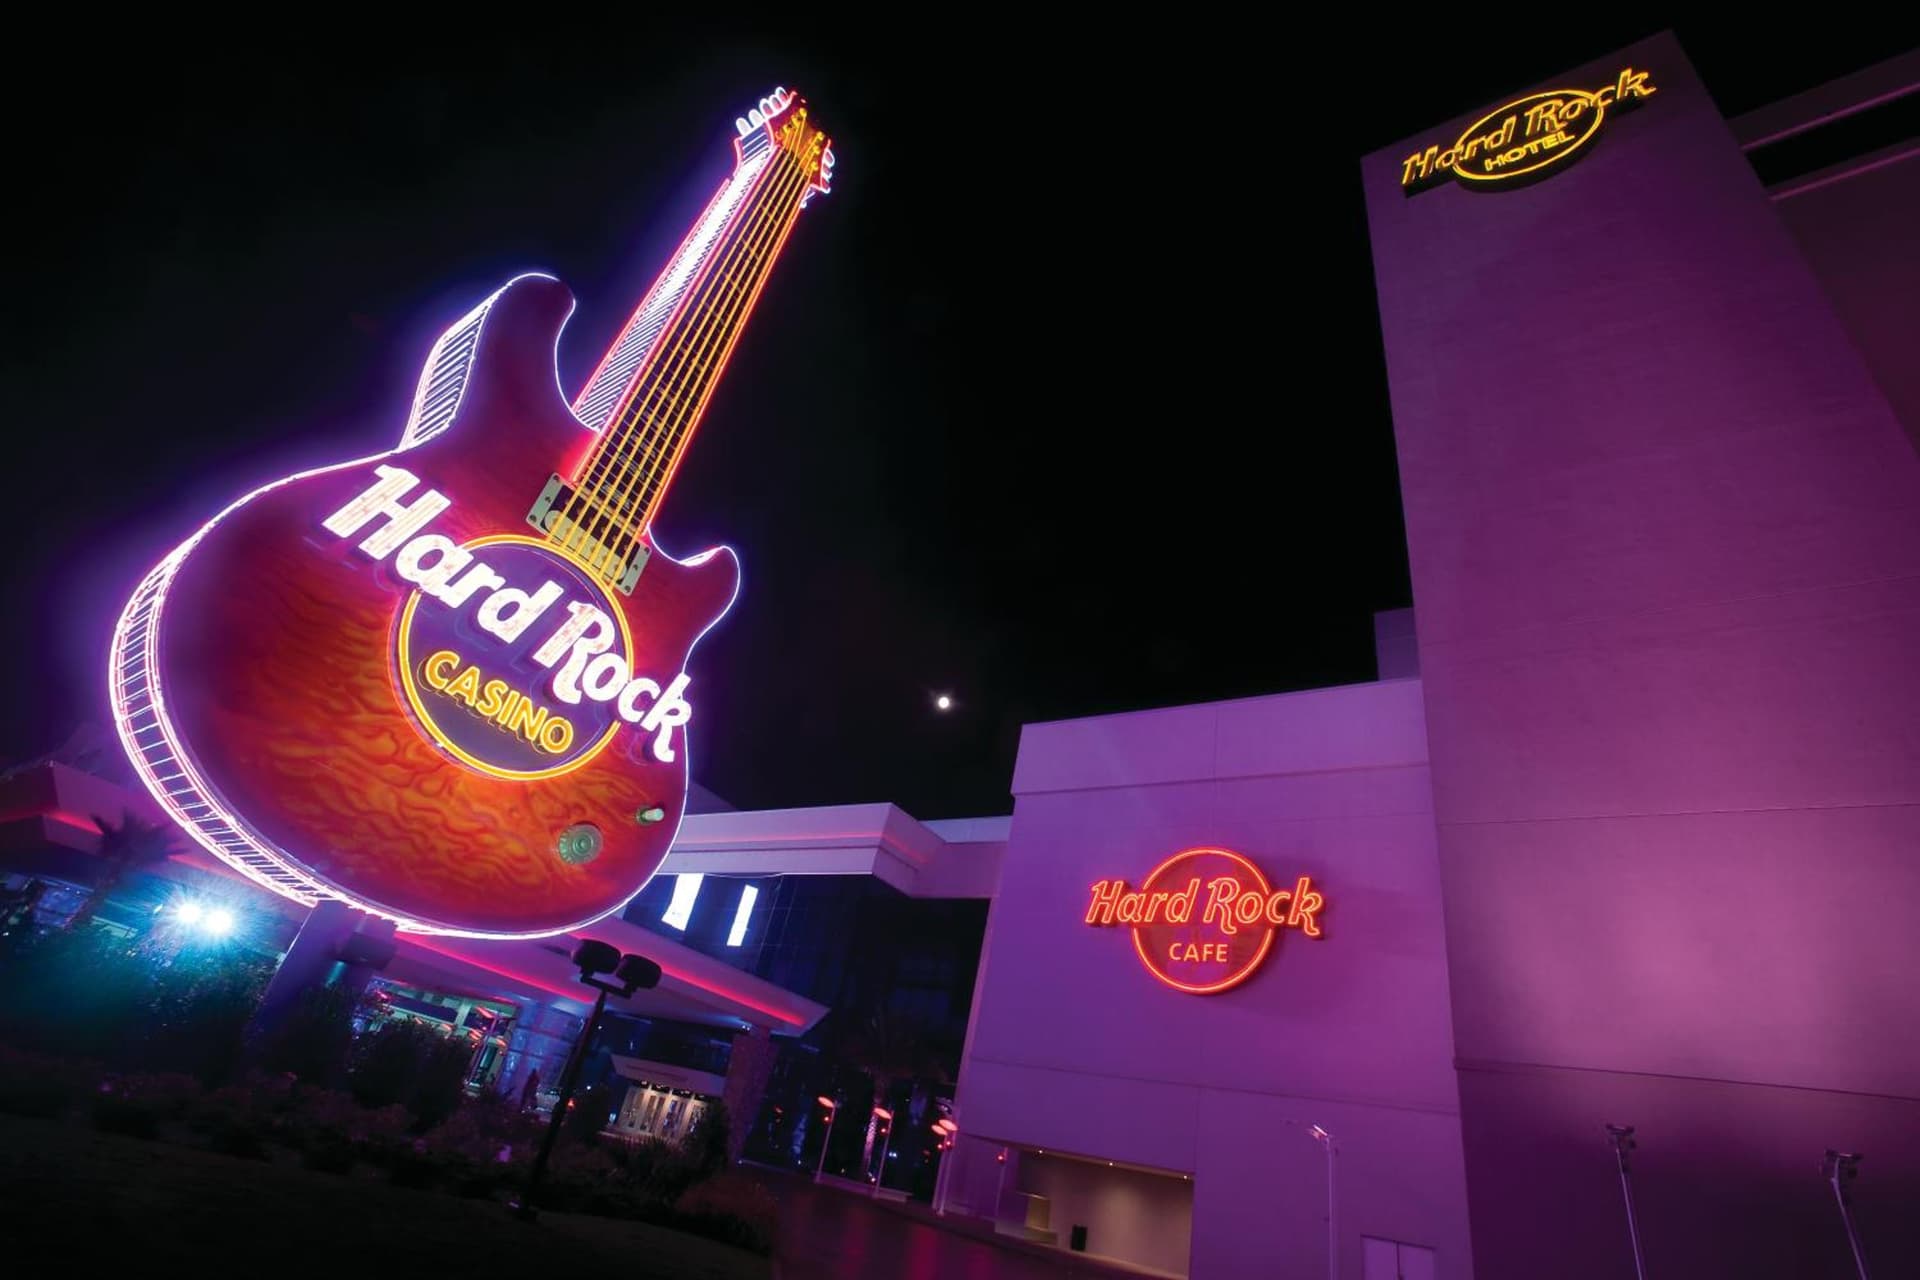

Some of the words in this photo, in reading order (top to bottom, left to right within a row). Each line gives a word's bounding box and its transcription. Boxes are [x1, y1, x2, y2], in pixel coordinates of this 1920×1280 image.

[1402, 114, 1516, 185] Hard
[1523, 67, 1656, 136] Rock
[1484, 130, 1575, 171] HOTEL
[321, 463, 564, 644] Hard
[531, 600, 692, 763] Rock
[424, 650, 574, 754] CASINO
[1085, 878, 1200, 924] Hard
[1202, 877, 1323, 936] Rock
[1169, 942, 1228, 962] CAFE
